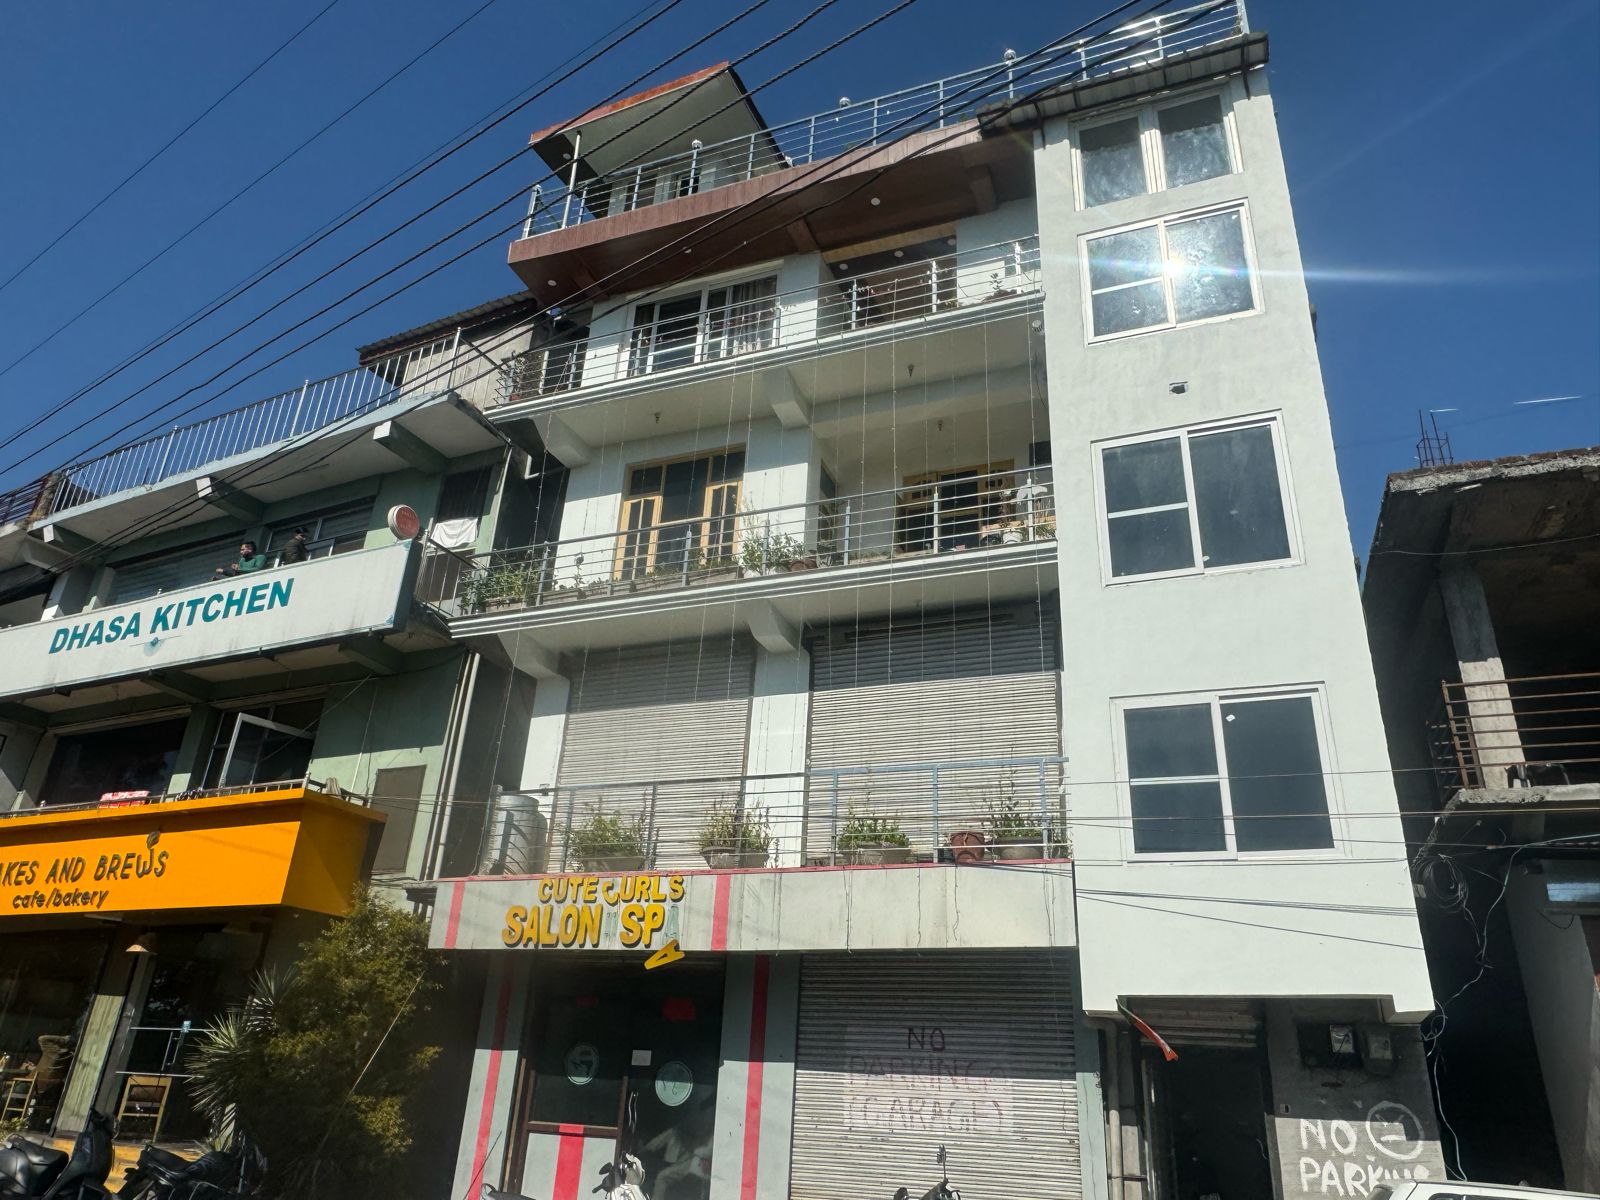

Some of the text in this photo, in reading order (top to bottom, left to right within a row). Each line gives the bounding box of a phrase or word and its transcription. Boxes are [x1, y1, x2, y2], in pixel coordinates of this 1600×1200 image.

[48, 578, 295, 655] DHASA KITCHEN
[0, 844, 169, 887] KES AND BREWS
[12, 887, 110, 909] cafe/bakery
[538, 875, 685, 906] CUTE CURLS
[502, 903, 604, 949] SALON
[907, 1026, 946, 1052] NO
[1300, 1119, 1357, 1155] NO
